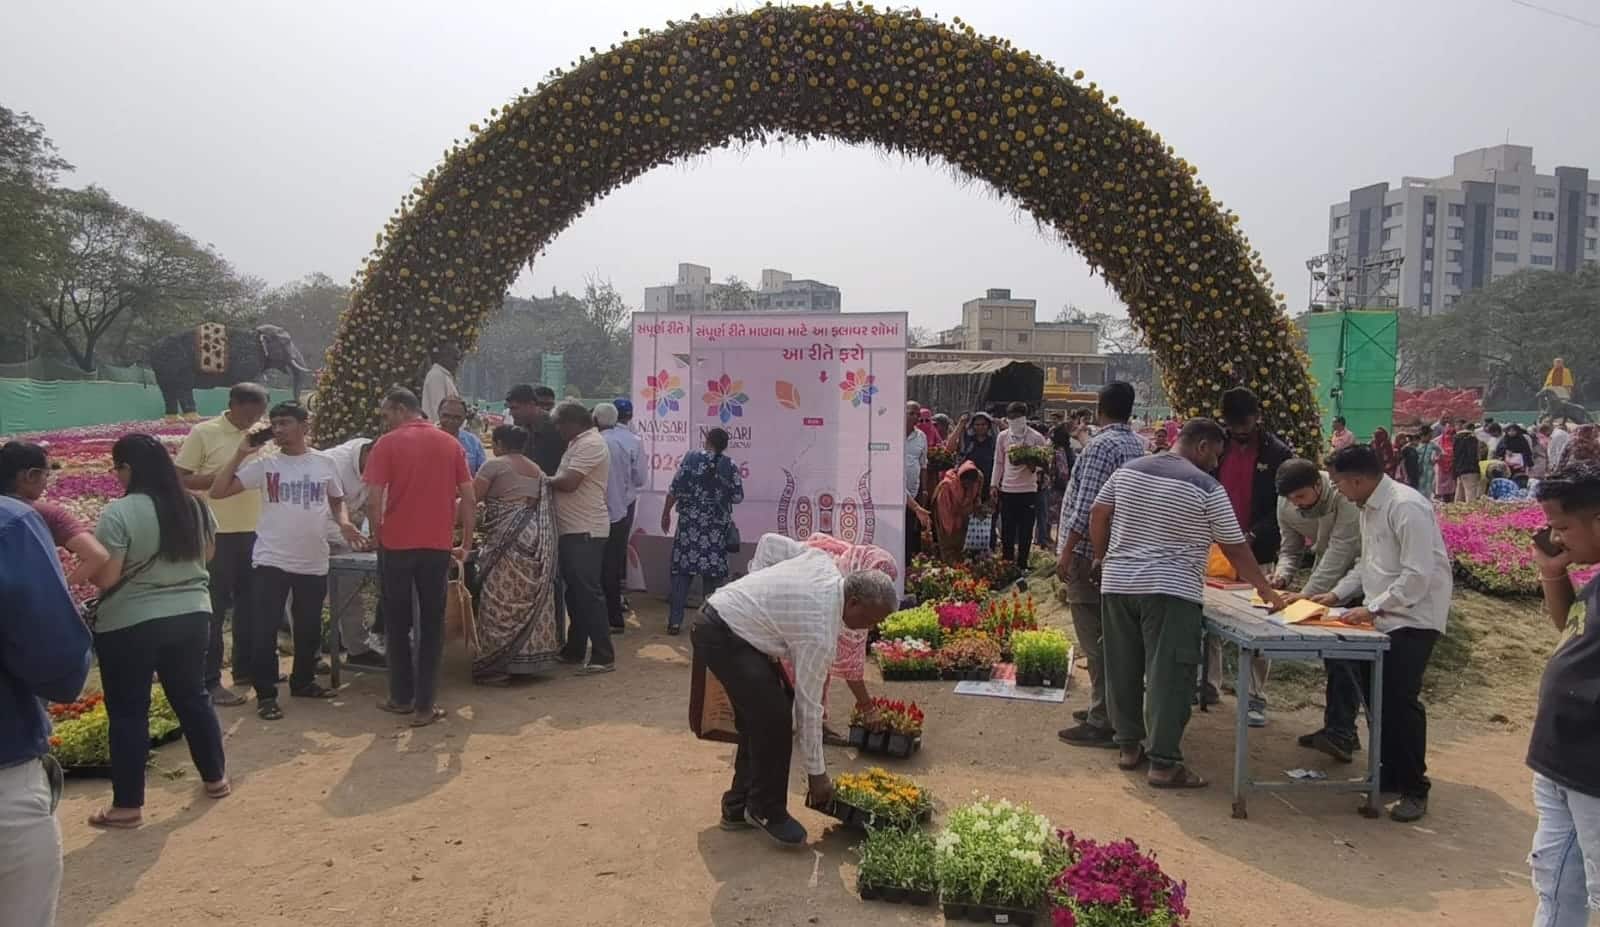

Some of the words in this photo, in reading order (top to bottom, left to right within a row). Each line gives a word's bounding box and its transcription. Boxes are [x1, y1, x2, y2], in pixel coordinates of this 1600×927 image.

[728, 323, 745, 337] રીતે
[749, 327, 784, 337] માણવા
[788, 323, 808, 337] માટે
[813, 326, 828, 337] આ
[783, 347, 803, 360] આ
[808, 343, 833, 360] રીતે
[839, 343, 864, 363] ફરો
[638, 420, 687, 434] NAVSARI
[699, 425, 751, 440] NSARI
